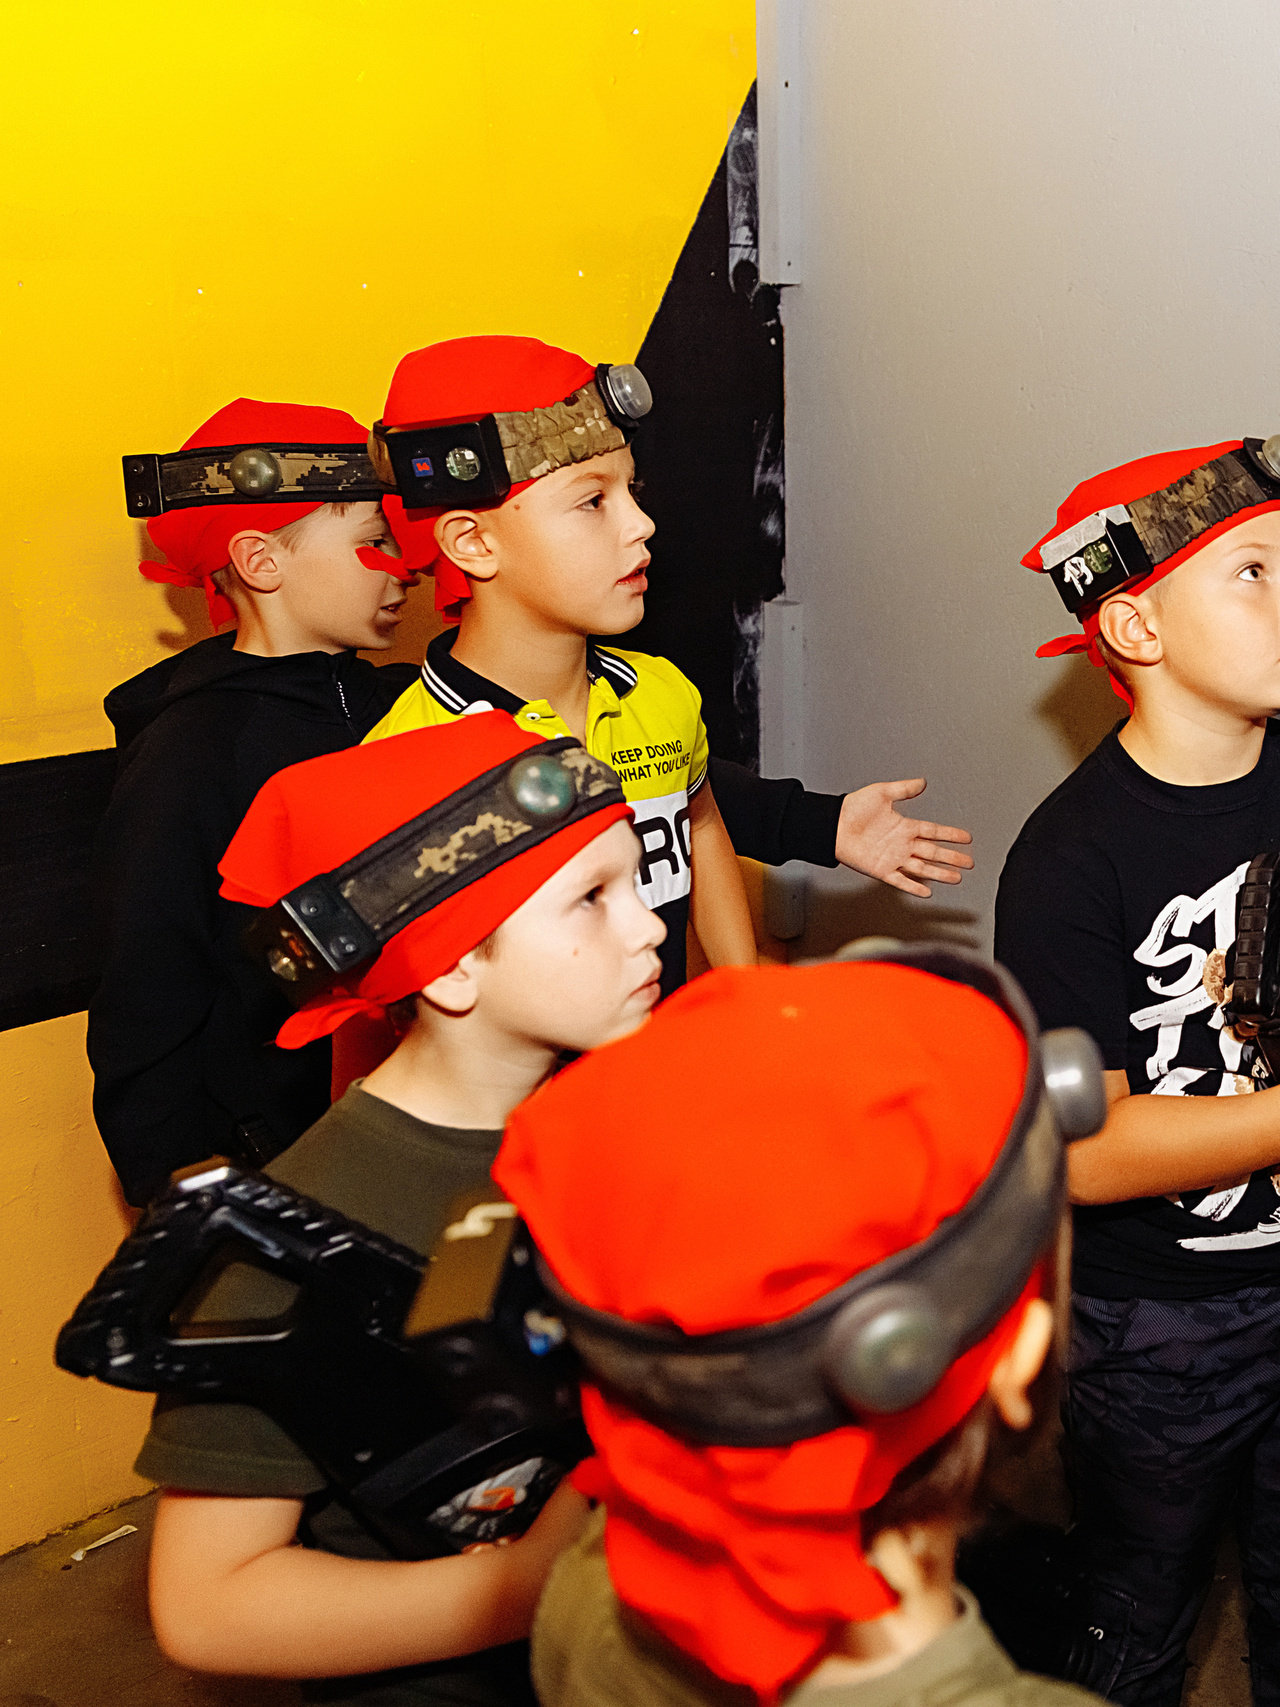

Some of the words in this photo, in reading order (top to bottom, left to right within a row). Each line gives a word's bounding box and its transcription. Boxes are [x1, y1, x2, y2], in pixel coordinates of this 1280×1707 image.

[611, 748, 643, 765] KEEP
[645, 740, 682, 759] DOING
[614, 764, 651, 783] WHAT
[654, 759, 675, 776] YOU
[676, 752, 690, 770] LIKE
